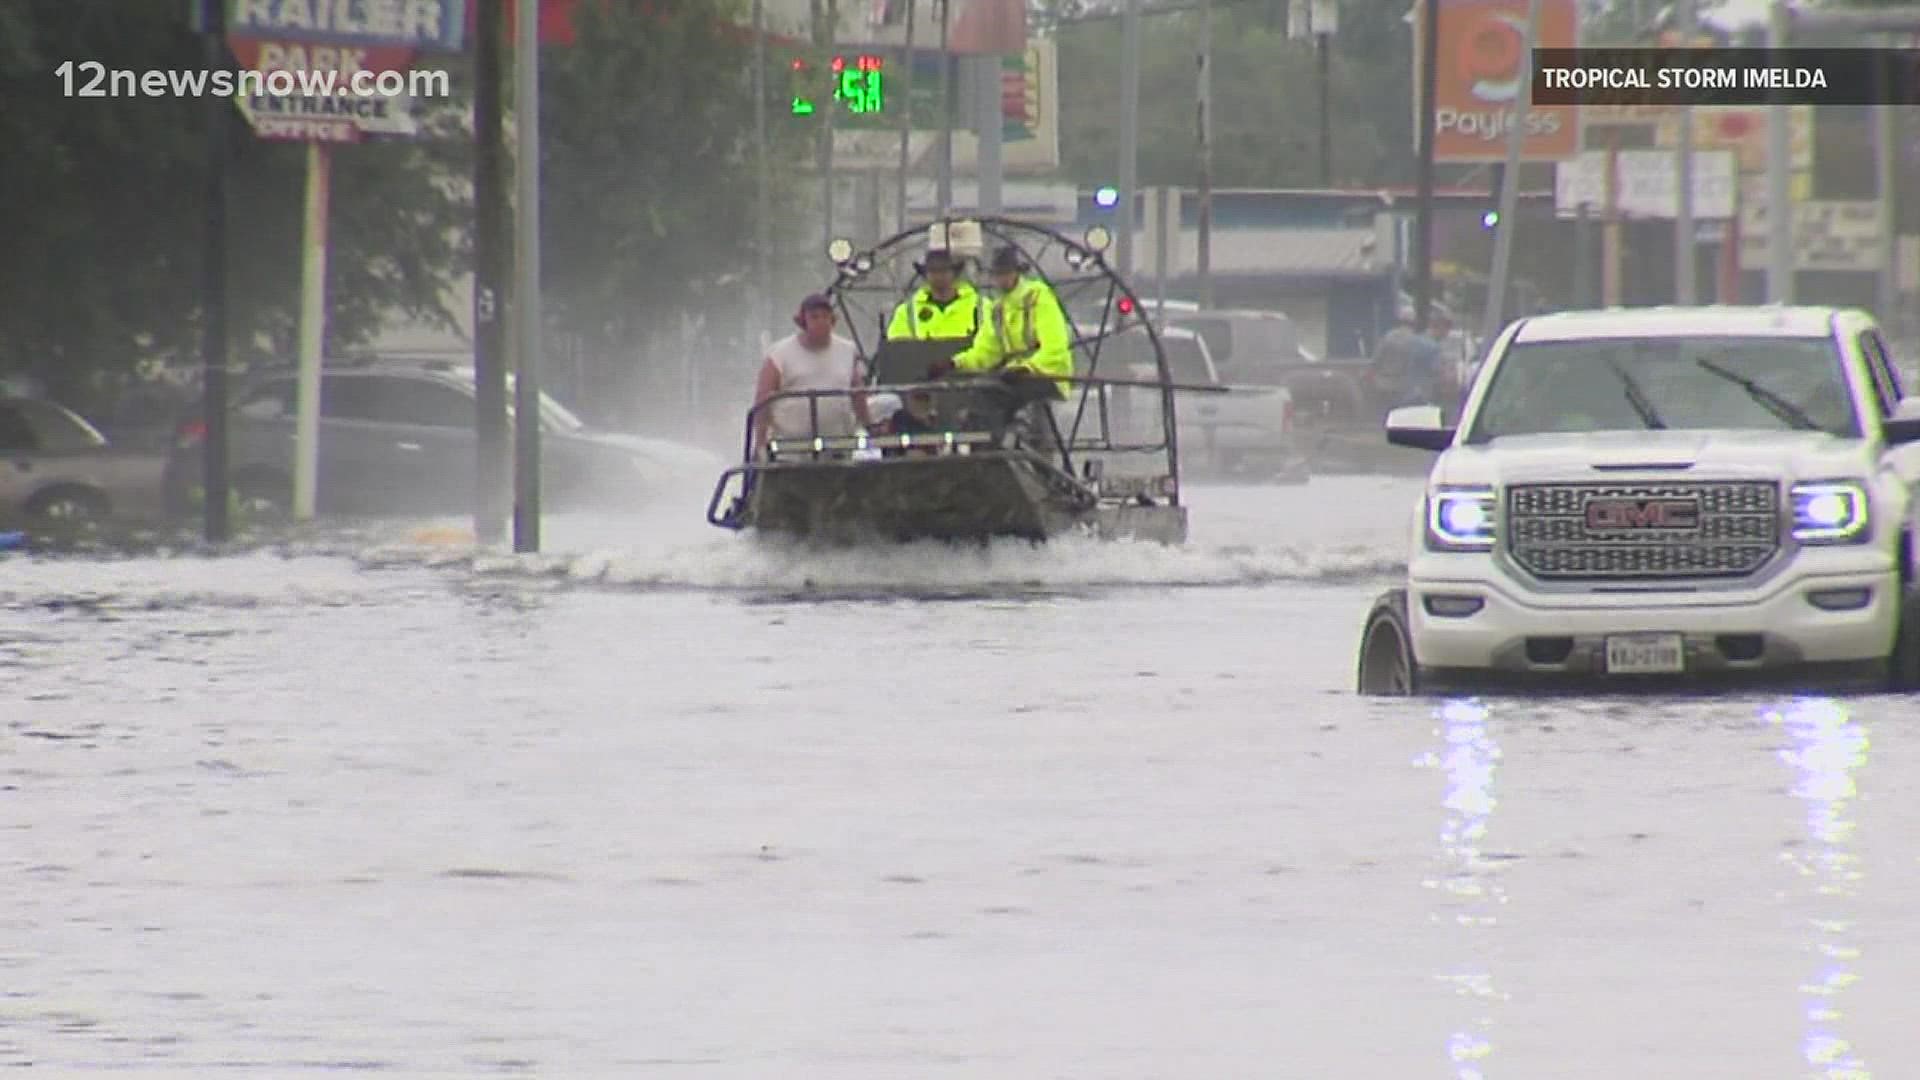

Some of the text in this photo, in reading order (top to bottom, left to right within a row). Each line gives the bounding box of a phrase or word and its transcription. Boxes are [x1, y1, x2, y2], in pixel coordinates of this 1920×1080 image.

[258, 41, 367, 83] PARK
[250, 96, 389, 118] ENTRANCE
[1585, 501, 1698, 529] GMC
